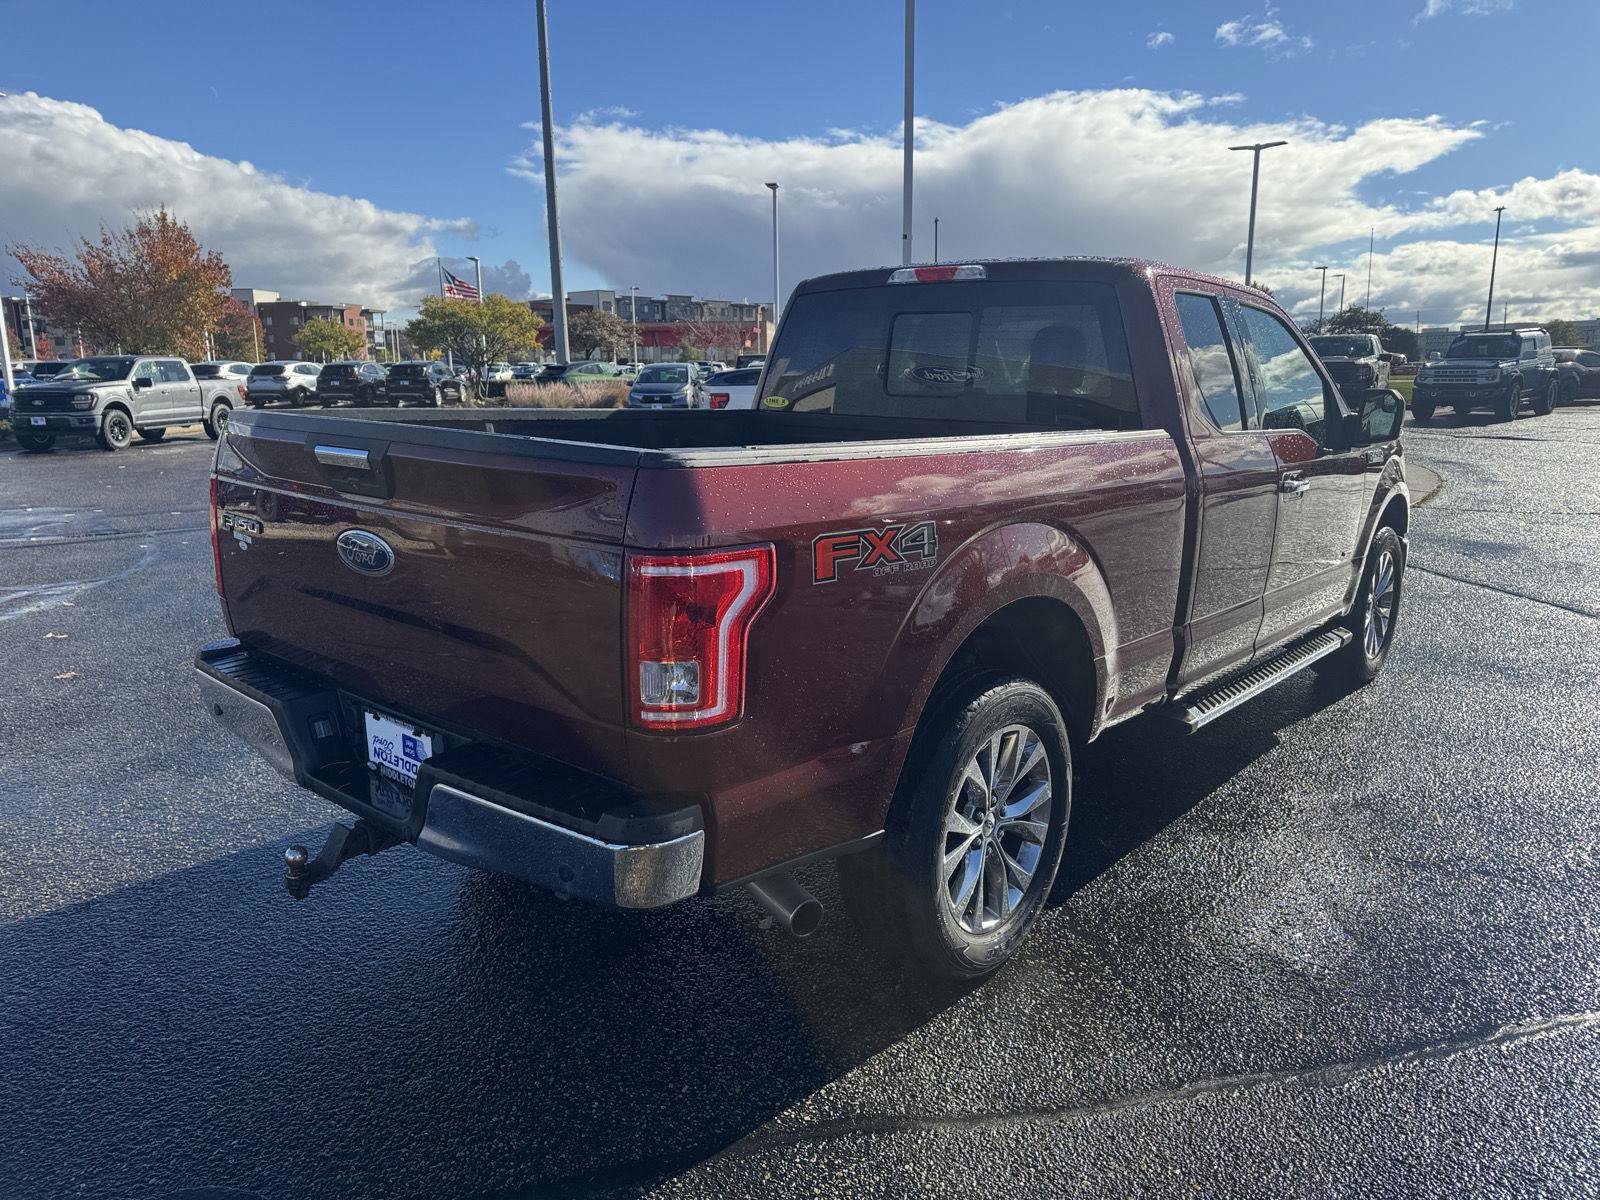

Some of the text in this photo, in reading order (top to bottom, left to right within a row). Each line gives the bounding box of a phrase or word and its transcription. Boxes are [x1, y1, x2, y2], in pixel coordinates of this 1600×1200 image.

[343, 535, 382, 568] Ford
[812, 521, 938, 585] FX4
[873, 559, 938, 577] OFF ROAD
[372, 735, 395, 755] Ford
[373, 746, 418, 776] DDLETON
